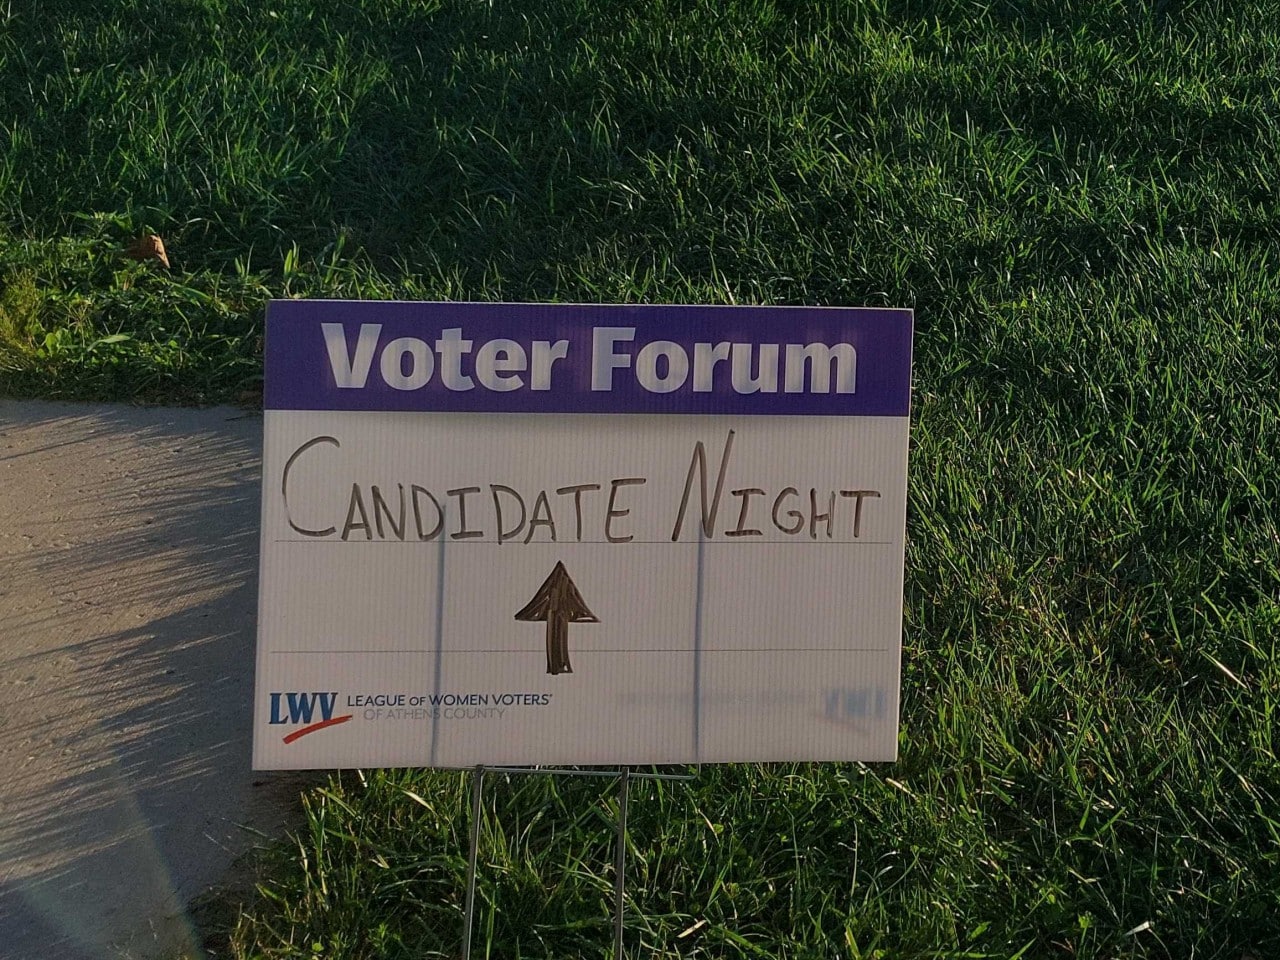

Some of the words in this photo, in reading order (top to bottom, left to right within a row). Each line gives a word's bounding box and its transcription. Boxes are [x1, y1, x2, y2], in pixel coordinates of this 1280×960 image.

[321, 322, 567, 391] Voter
[590, 326, 858, 395] Forum
[269, 692, 337, 725] LWV
[347, 694, 405, 708] LEAGUE
[429, 694, 488, 707] WOMEN
[363, 709, 384, 721] OF
[386, 708, 440, 720] ATHENS
[443, 707, 506, 720] COUNTY
